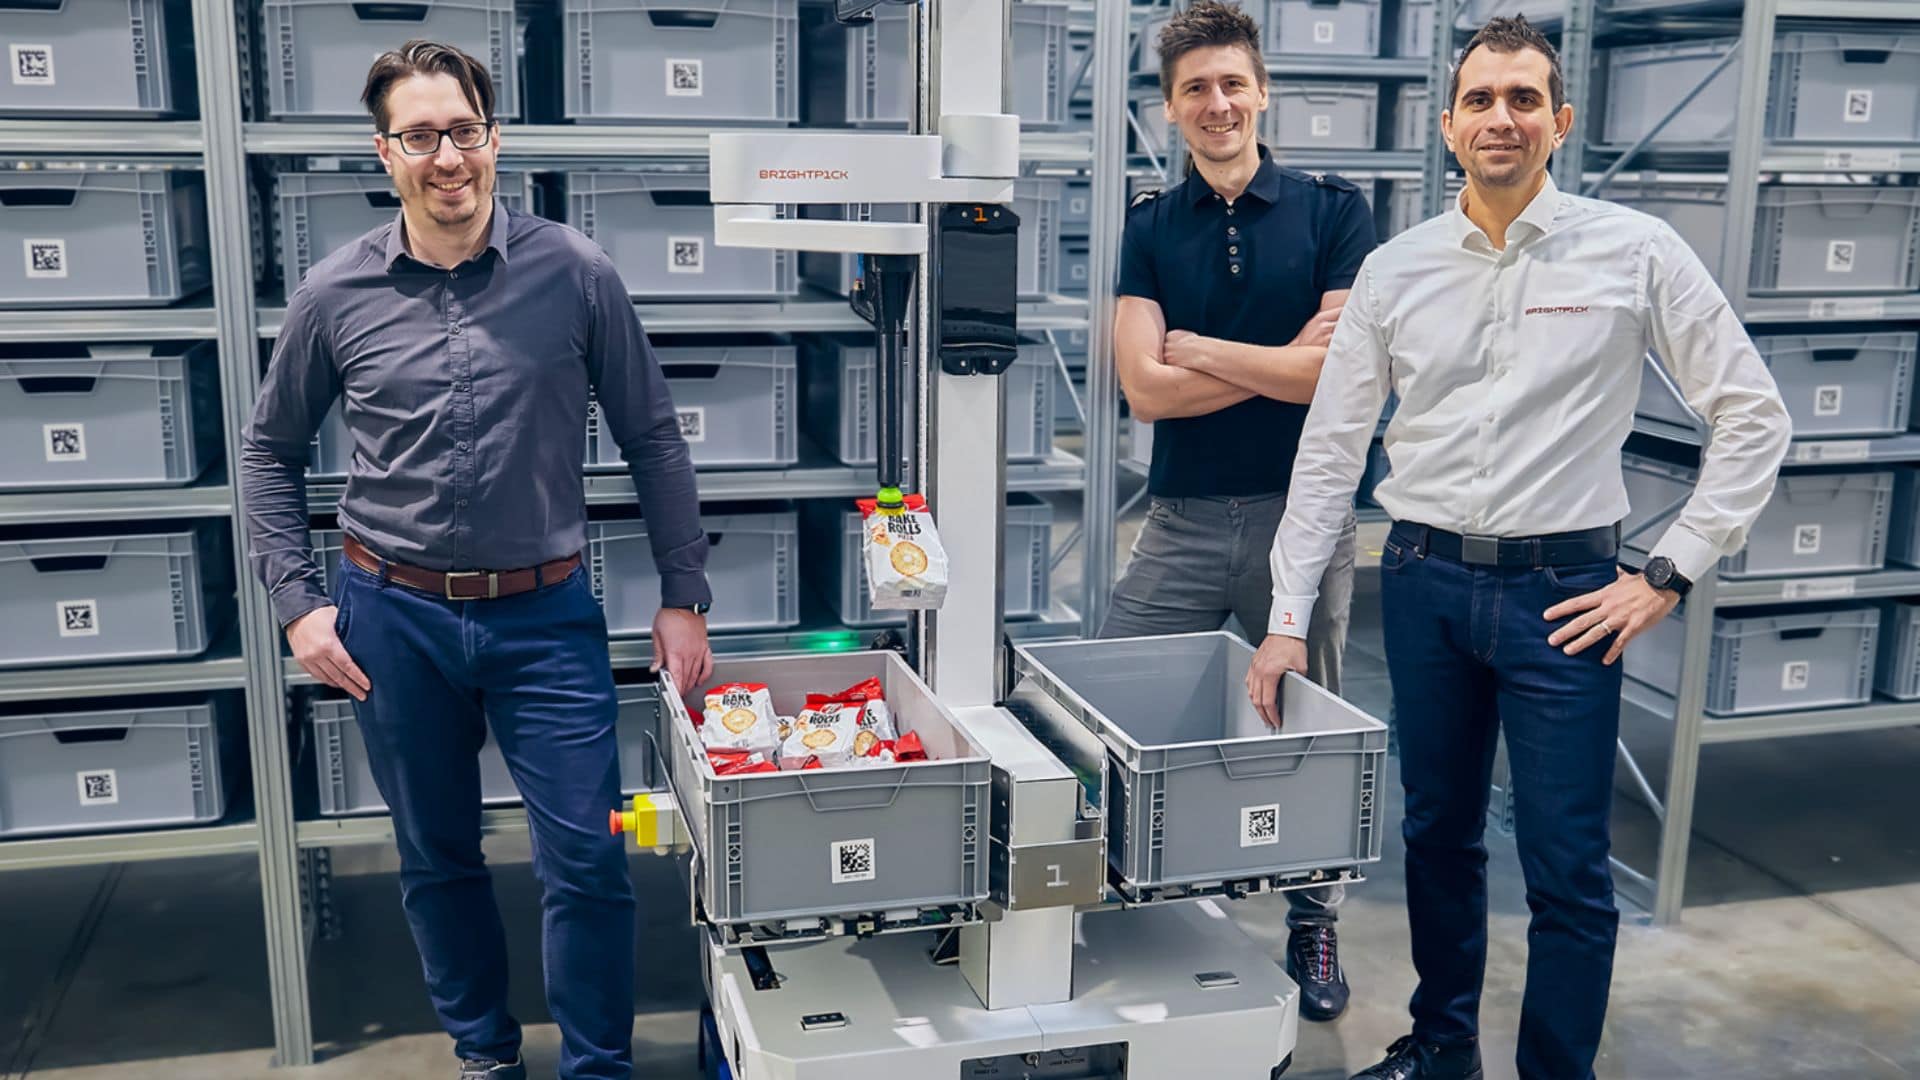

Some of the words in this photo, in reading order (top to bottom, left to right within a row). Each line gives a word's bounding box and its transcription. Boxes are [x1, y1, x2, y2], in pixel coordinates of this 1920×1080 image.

[974, 207, 988, 222] 1
[888, 513, 918, 524] BAKE
[888, 522, 921, 535] ROLLS
[1283, 612, 1296, 625] 1
[1047, 865, 1069, 887] 1
